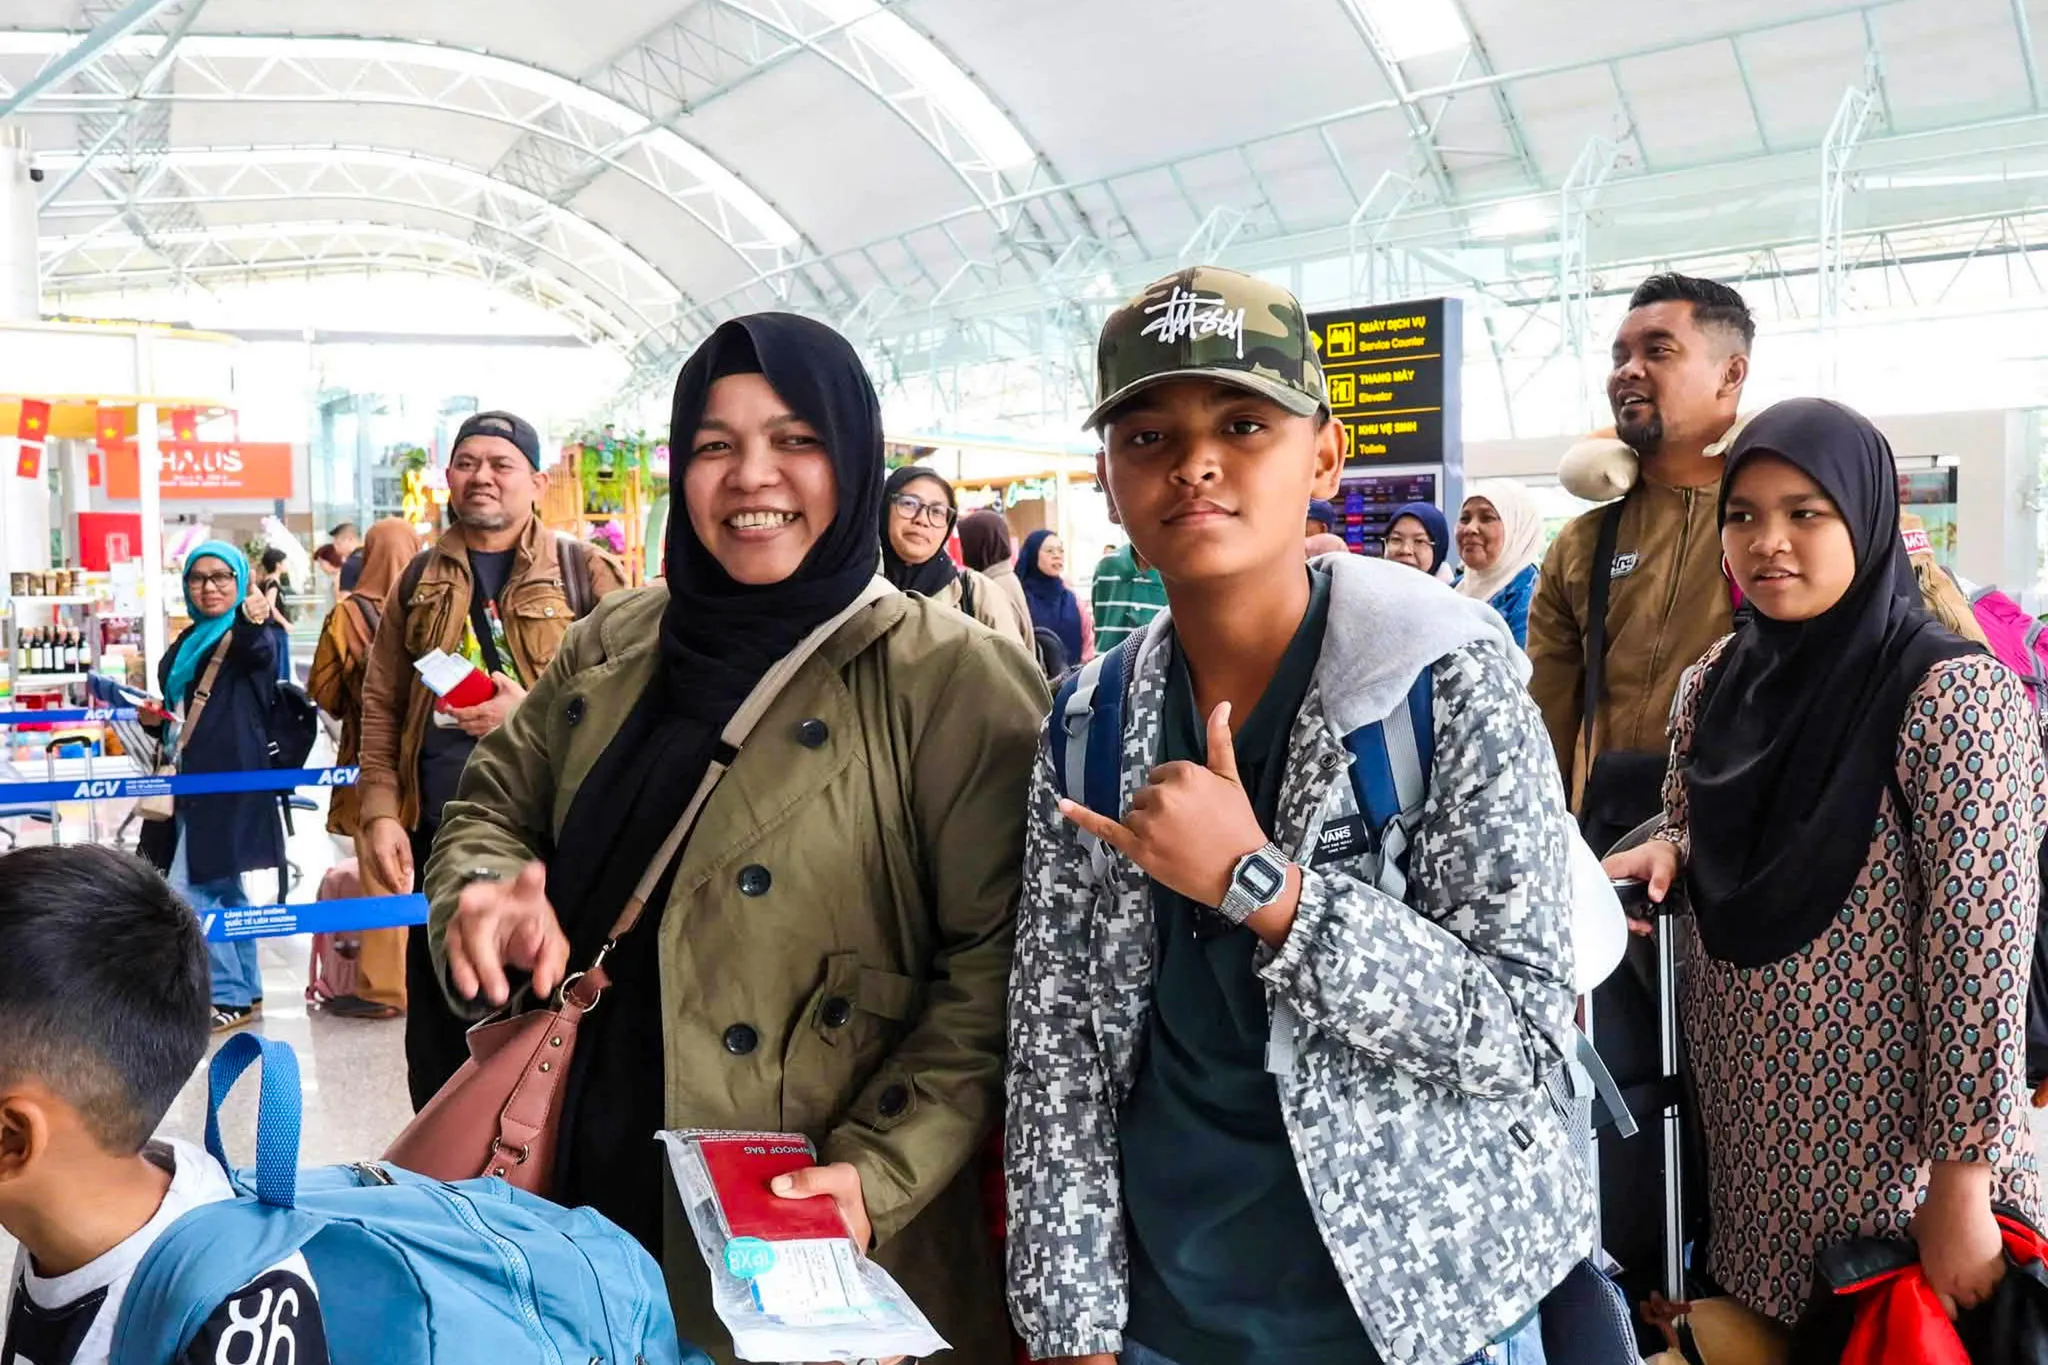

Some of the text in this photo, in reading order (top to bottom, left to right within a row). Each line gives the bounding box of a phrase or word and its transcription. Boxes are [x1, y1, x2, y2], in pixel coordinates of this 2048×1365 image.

[1359, 337, 1426, 352] Service Counter
[1359, 373, 1391, 385] THANG
[1359, 392, 1393, 403] Elevator
[1358, 424, 1378, 435] KHU
[1394, 421, 1417, 433] SINH
[1359, 444, 1387, 454] Toilets
[83, 708, 115, 720] ACV
[317, 767, 361, 785] ACV
[73, 780, 121, 798] ACV
[1319, 825, 1352, 844] VANS
[743, 1146, 766, 1155] BAG
[727, 1247, 769, 1271] IPX8
[214, 1287, 300, 1365] 86
